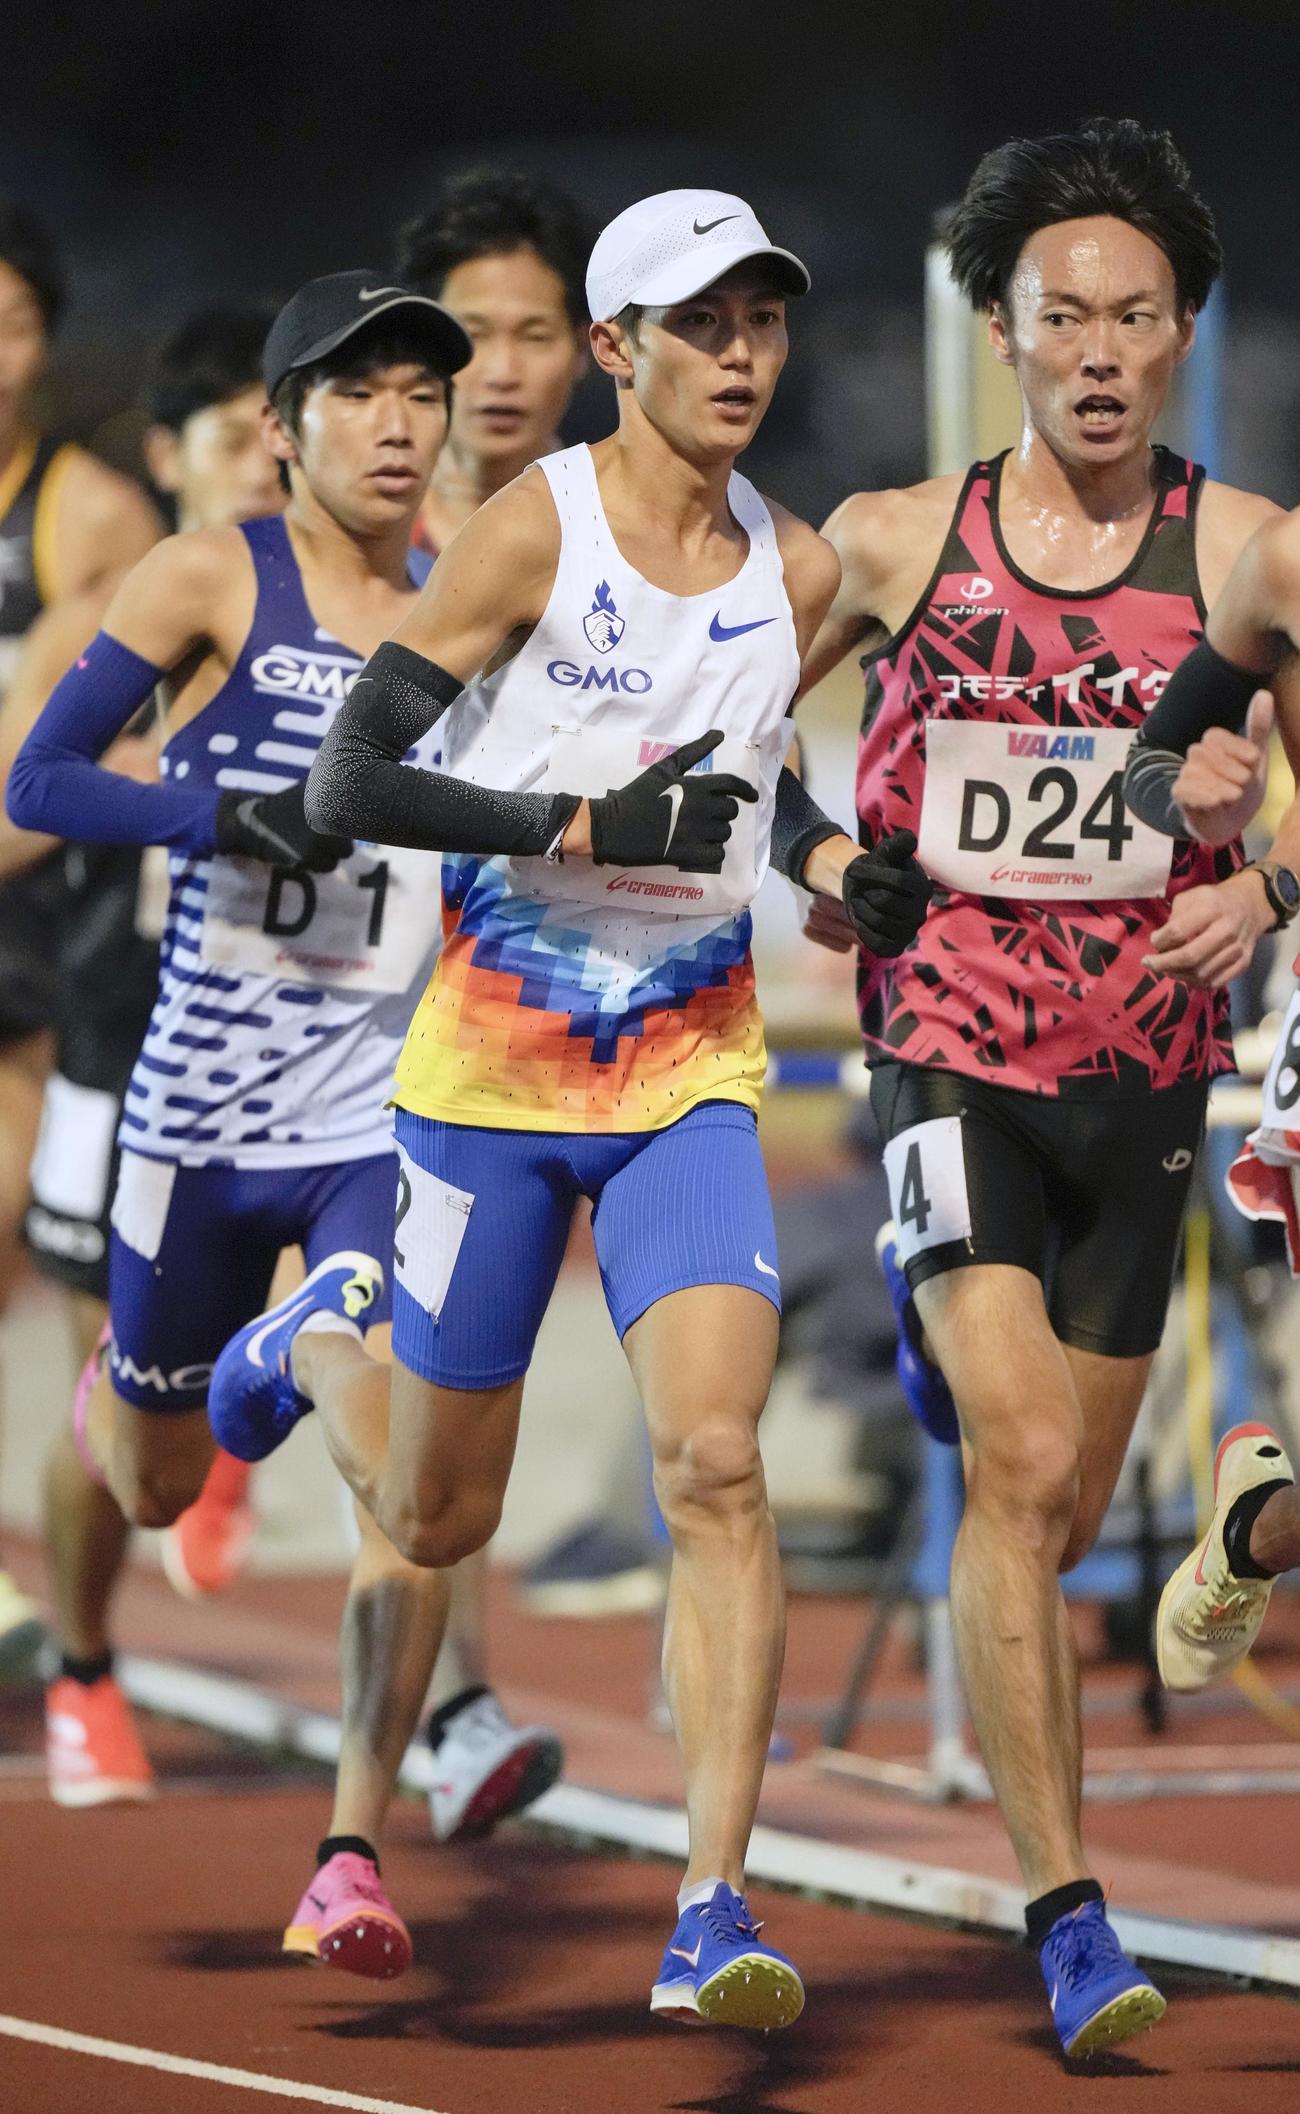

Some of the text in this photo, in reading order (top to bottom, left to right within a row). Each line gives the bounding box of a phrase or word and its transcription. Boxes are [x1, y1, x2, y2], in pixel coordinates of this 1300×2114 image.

[944, 605, 1010, 618] phiten
[547, 660, 653, 694] GMO
[1008, 730, 1096, 760] VAAM
[958, 766, 1134, 861] D24
[262, 860, 389, 946] D 1
[900, 1141, 932, 1234] 4
